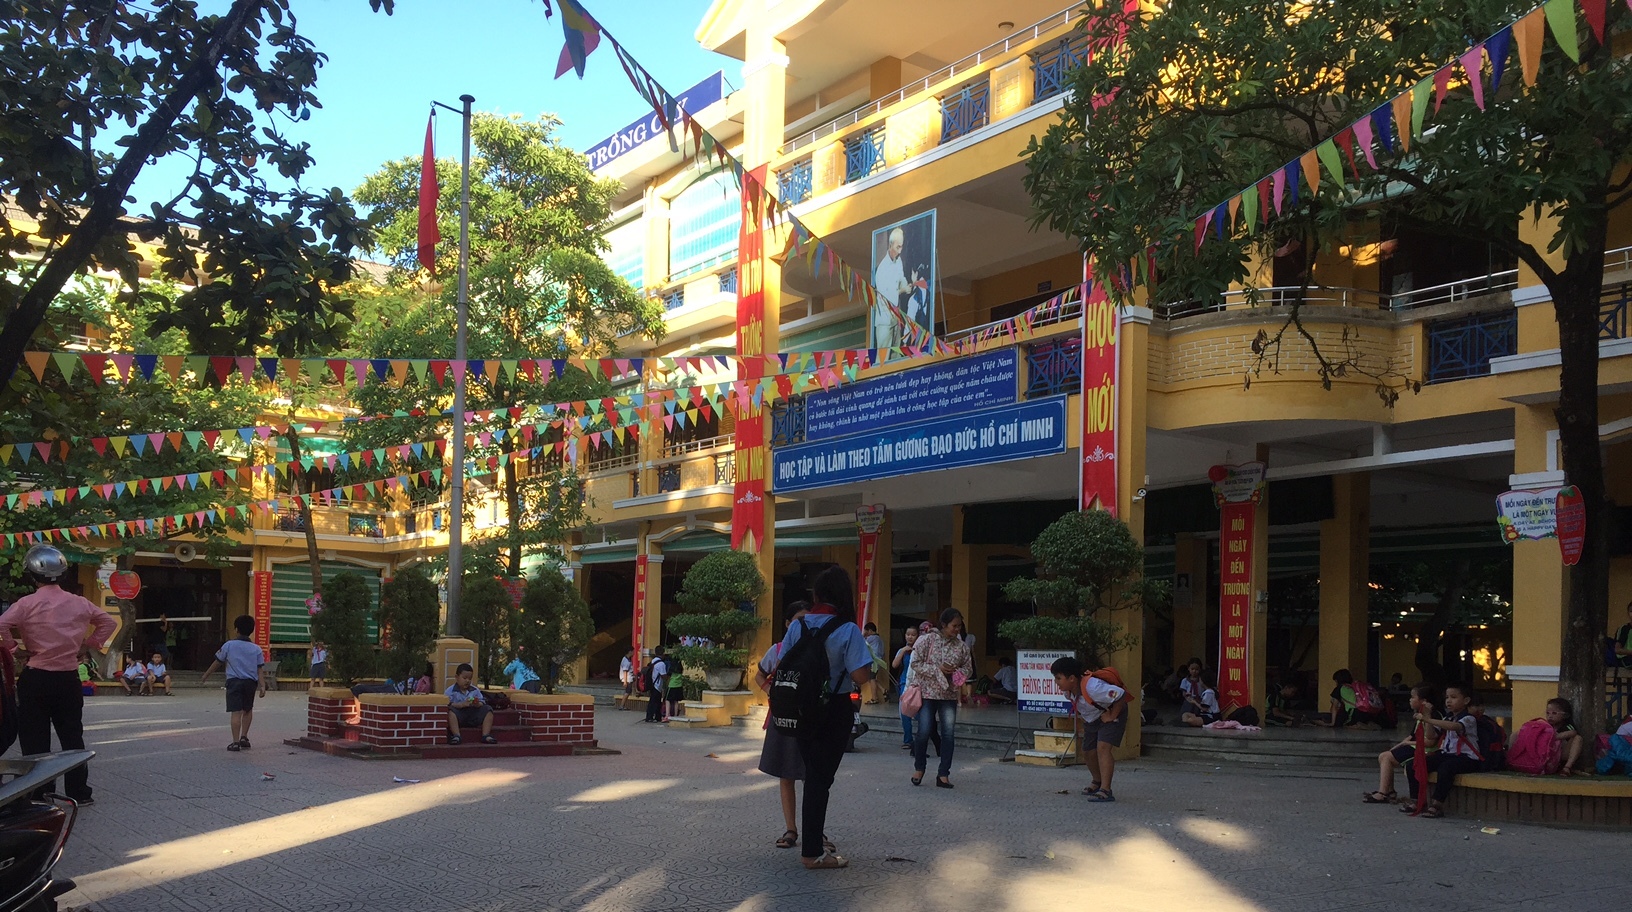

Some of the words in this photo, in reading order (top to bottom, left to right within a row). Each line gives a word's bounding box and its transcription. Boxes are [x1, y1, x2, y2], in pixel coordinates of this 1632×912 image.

[651, 97, 688, 134] CY
[909, 378, 919, 387] đẹp
[921, 376, 932, 385] hay
[956, 367, 968, 377] dân
[970, 365, 980, 374] tộc
[982, 361, 996, 371] Việt
[997, 358, 1013, 368] Nam
[950, 382, 964, 393] quốc
[966, 379, 980, 387] năm
[981, 374, 996, 384] châu
[997, 371, 1013, 382] được
[927, 401, 938, 410] học
[938, 398, 949, 407] tập
[963, 393, 974, 401] các
[1087, 372, 1114, 434] MỚI
[780, 461, 795, 482] HỌC
[798, 455, 812, 480] TẬP
[815, 452, 825, 474] VÀ
[828, 450, 846, 472] LÀM
[848, 447, 870, 468] THEO
[872, 438, 892, 465] TẤM
[895, 437, 928, 461] GƯƠNG
[931, 434, 952, 458] ĐẠO
[955, 426, 976, 452] ĐỨC
[980, 420, 995, 448] HỒ
[998, 418, 1018, 446] CHÍ
[1021, 416, 1053, 442] MINH
[1516, 498, 1531, 507] NGÀY
[1229, 536, 1247, 552] NGÀY
[1231, 557, 1244, 574] ĐẾN
[1232, 601, 1240, 616] LÀ
[1229, 623, 1243, 640] MỘT
[1226, 644, 1245, 659] NGÀY
[1229, 668, 1240, 680] VUI
[1022, 674, 1041, 694] PHÒNG
[1042, 679, 1053, 694] GHI
